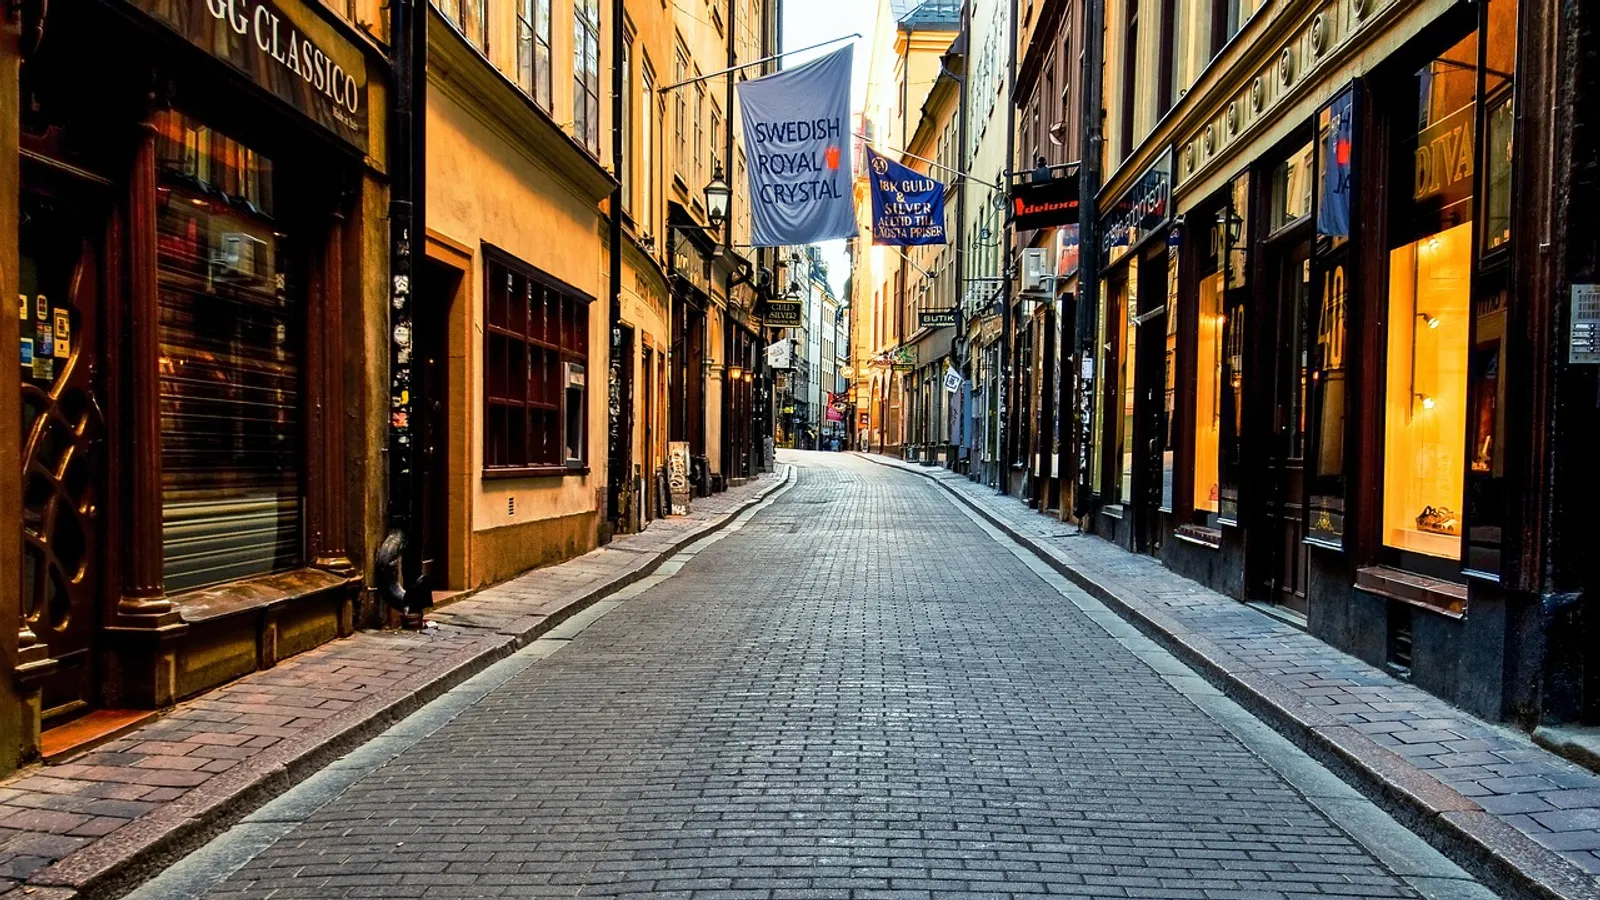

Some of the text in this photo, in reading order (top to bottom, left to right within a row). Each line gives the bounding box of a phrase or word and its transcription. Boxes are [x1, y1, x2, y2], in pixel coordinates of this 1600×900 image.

[254, 5, 358, 114] CLASSICO
[756, 117, 840, 144] SWEDISH
[759, 152, 822, 175] ROYAL
[1413, 121, 1475, 199] DIVA
[760, 179, 842, 204] CRYSTAL
[880, 179, 935, 193] 18K GULD
[896, 191, 905, 202] &
[884, 202, 932, 215] SILVER
[878, 214, 936, 227] ALLTID TILL
[910, 225, 944, 239] PRISER
[923, 314, 955, 322] BUTIK
